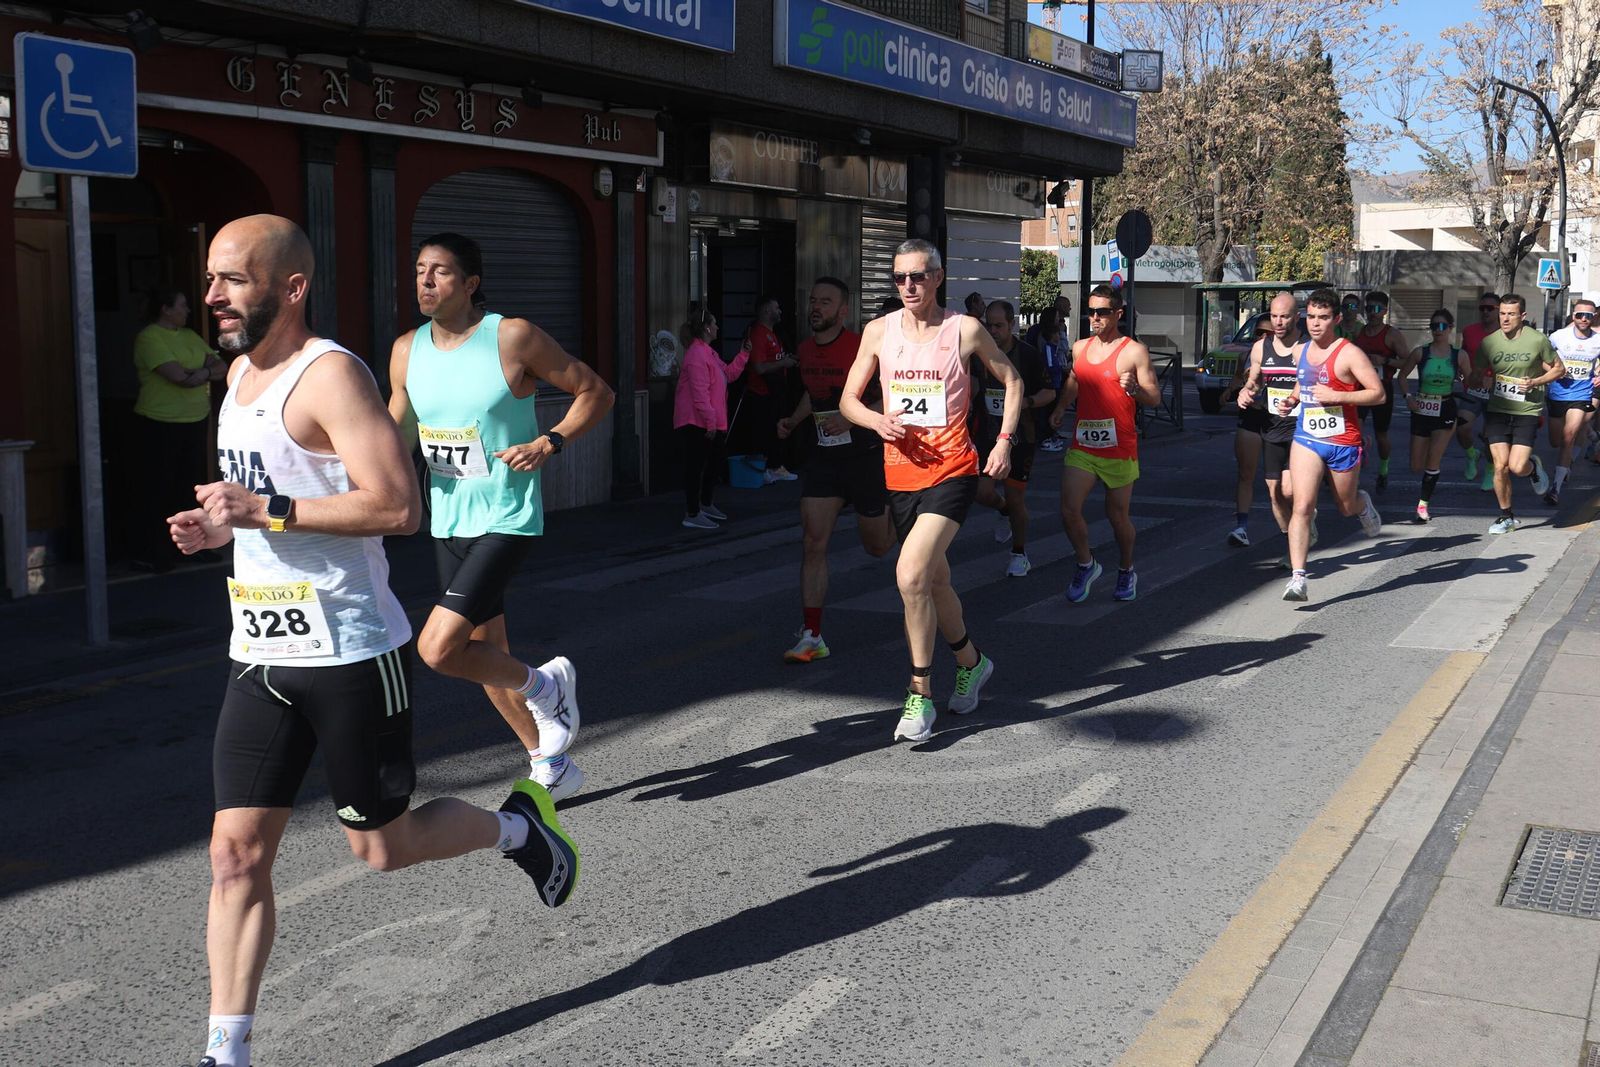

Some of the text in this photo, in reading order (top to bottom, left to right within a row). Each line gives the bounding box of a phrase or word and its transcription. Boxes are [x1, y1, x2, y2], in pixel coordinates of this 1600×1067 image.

[1090, 50, 1109, 67] Centro
[226, 55, 622, 145] GENESYS Pub
[963, 58, 1009, 104] Cristo
[1015, 78, 1034, 110] de
[1039, 85, 1052, 114] la
[1057, 86, 1092, 125] Salud
[752, 130, 820, 166] COFFEE
[1503, 351, 1532, 362] asics
[894, 369, 942, 380] MOTRIL
[1496, 381, 1521, 395] 314
[901, 397, 928, 415] 24
[1309, 417, 1337, 430] 908
[1082, 430, 1111, 442] 192
[427, 444, 470, 466] 777
[243, 608, 311, 638] 328
